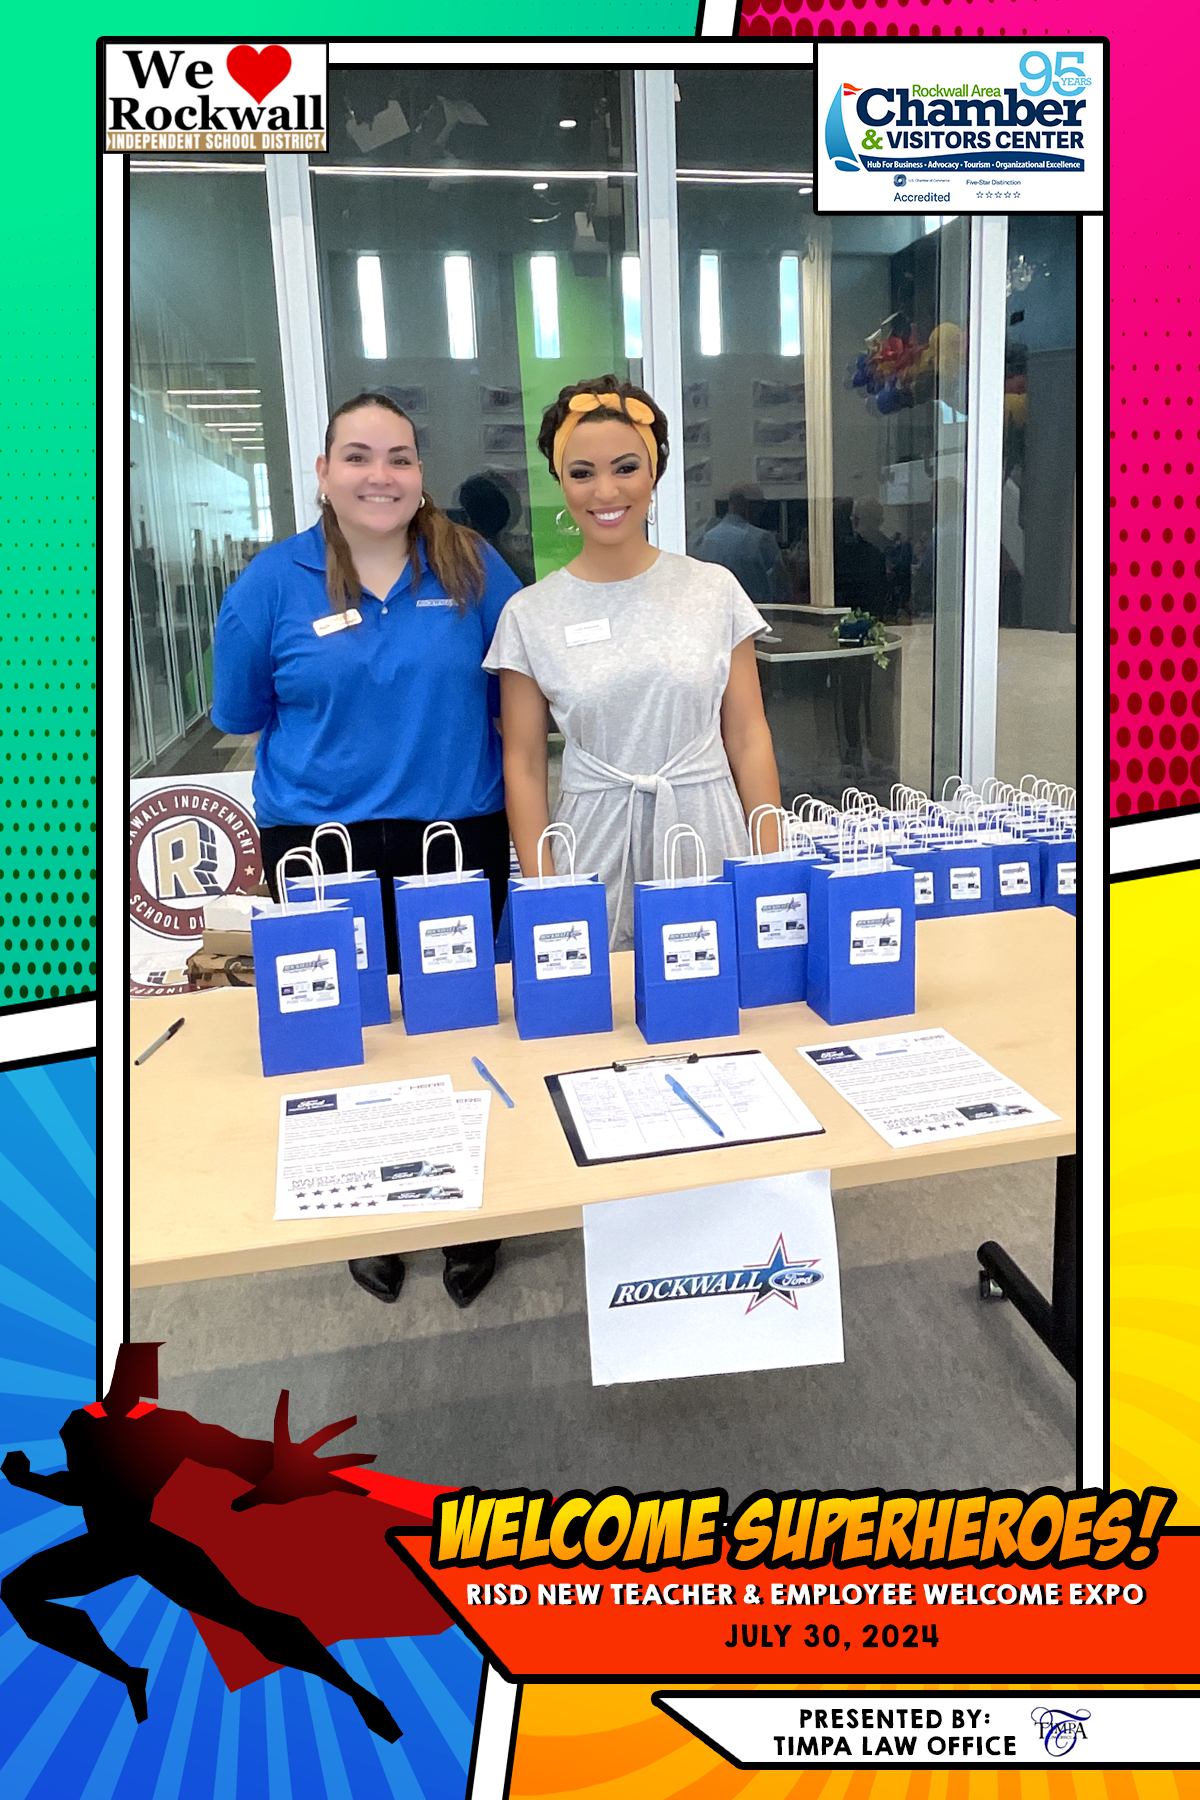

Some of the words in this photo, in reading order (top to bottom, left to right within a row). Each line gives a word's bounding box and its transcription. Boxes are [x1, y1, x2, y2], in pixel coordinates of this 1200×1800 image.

[174, 795, 256, 856] INDEPENDENT
[130, 894, 180, 930] SCHOOL
[614, 1271, 764, 1304] ROCKWALL
[781, 1272, 814, 1286] Ford
